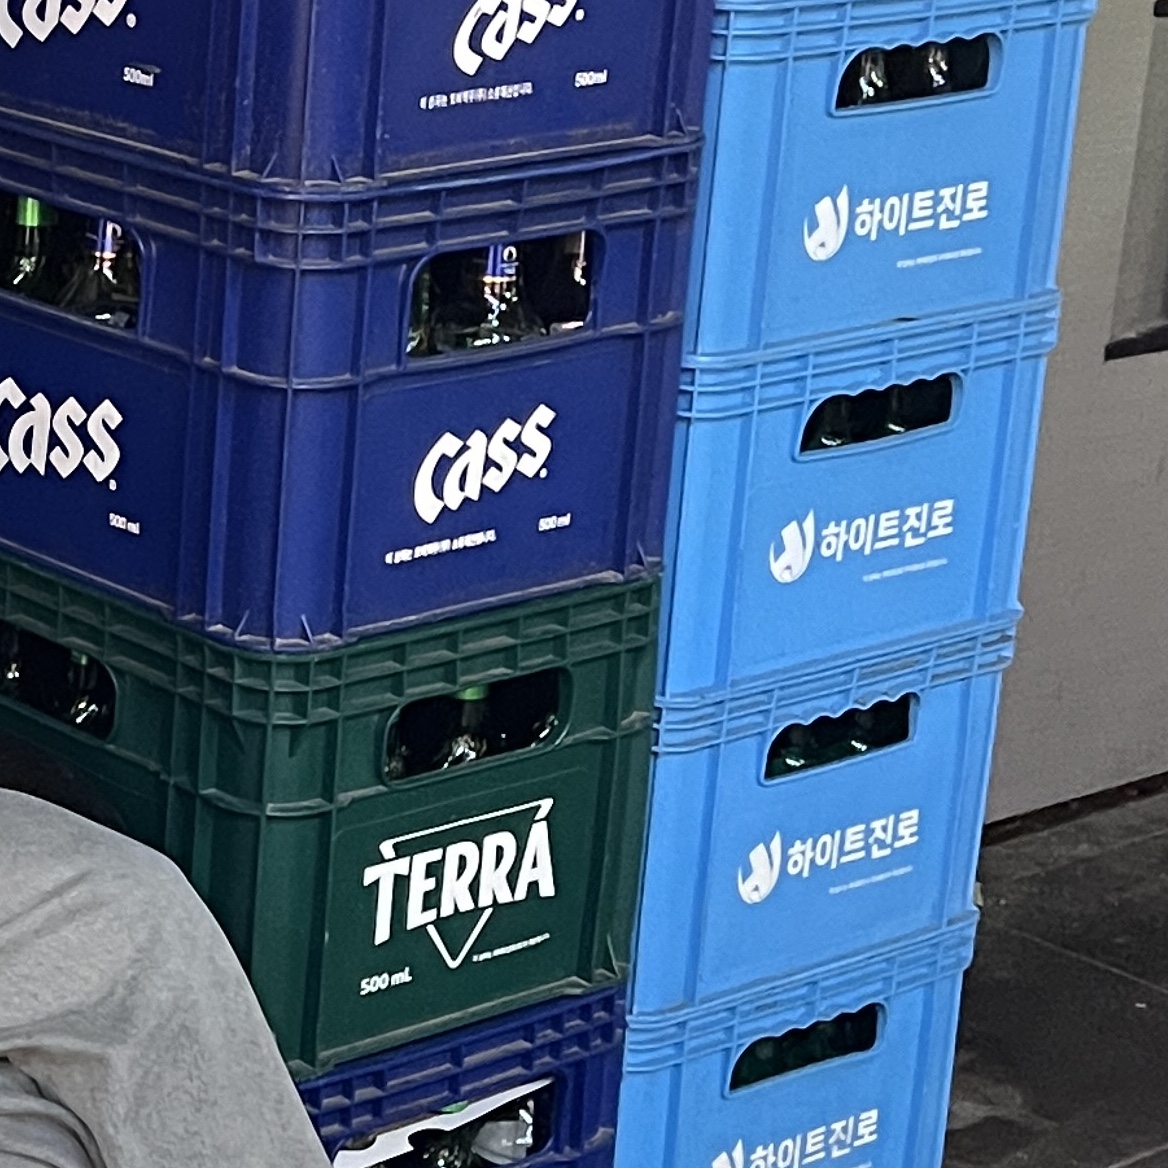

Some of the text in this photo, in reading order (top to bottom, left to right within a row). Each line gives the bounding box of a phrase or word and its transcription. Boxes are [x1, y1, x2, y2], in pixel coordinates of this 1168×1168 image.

[854, 180, 989, 241] 하이트진로
[413, 403, 557, 525] Cass
[820, 499, 955, 562] 하이트진로
[787, 808, 920, 878] 하이트진로
[363, 820, 556, 946] TERRA
[360, 966, 413, 996] 500 mL
